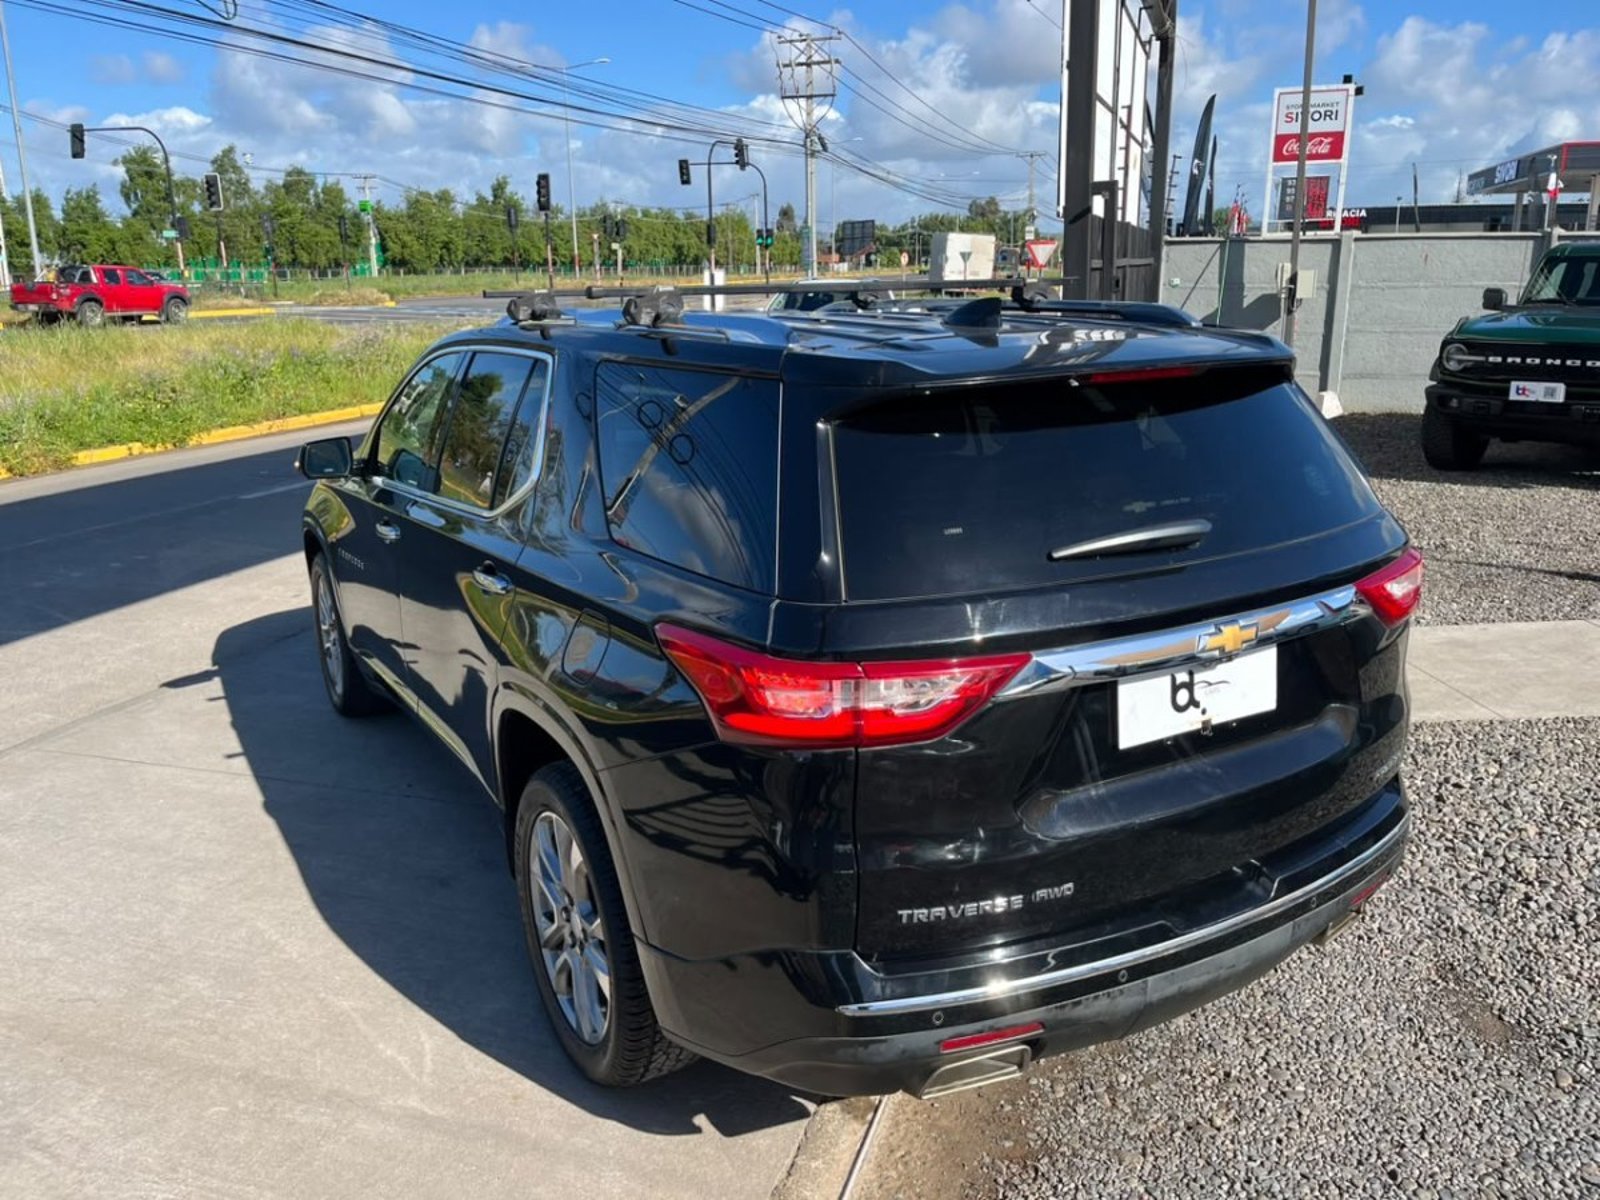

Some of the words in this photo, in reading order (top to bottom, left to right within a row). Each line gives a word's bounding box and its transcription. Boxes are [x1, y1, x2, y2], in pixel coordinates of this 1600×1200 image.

[1285, 109, 1338, 123] SIORI
[1488, 356, 1600, 367] BRONCO
[898, 895, 1023, 923] TRAVERSE
